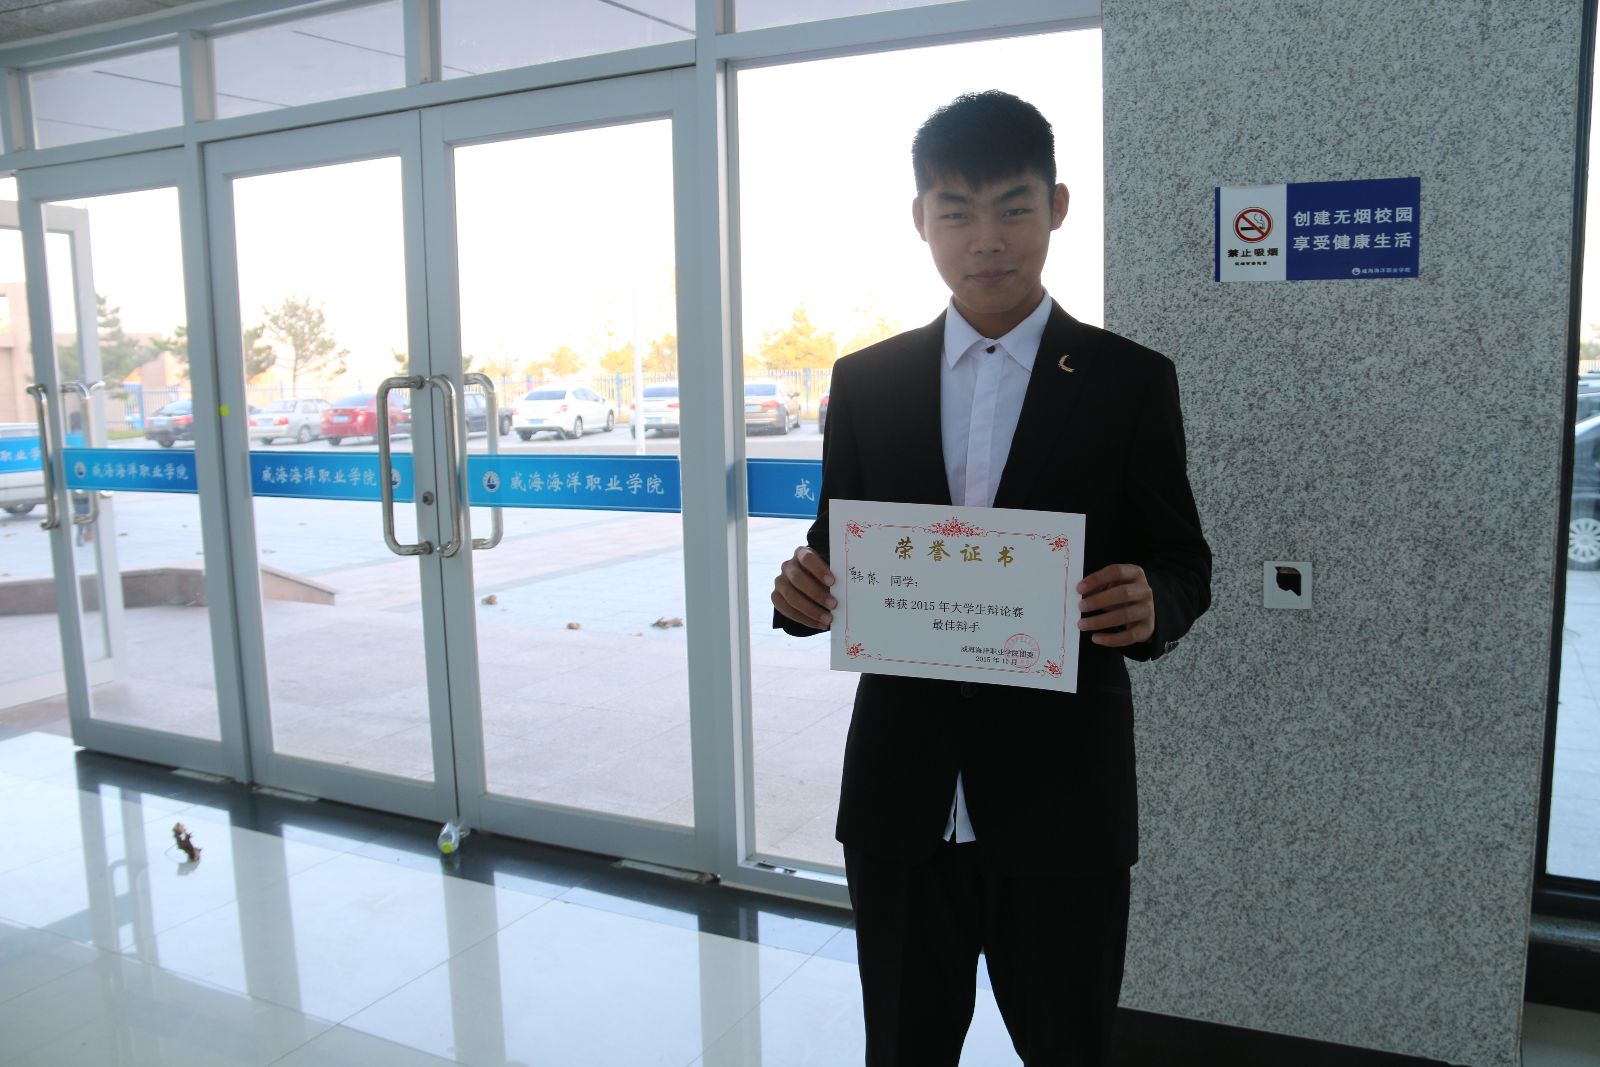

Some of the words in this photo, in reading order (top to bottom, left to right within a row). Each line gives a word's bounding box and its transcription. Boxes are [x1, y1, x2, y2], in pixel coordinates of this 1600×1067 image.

[1293, 206, 1413, 227] 创建无烟校园
[1293, 232, 1413, 251] 享受健康生活
[1227, 247, 1279, 258] 禁止吸烟
[261, 465, 377, 487] 威海海洋职业学院
[510, 472, 665, 495] 威海海洋职业学院
[794, 478, 815, 502] 威
[894, 536, 1015, 567] 荣誉证书
[932, 618, 980, 632] 最佳辩手
